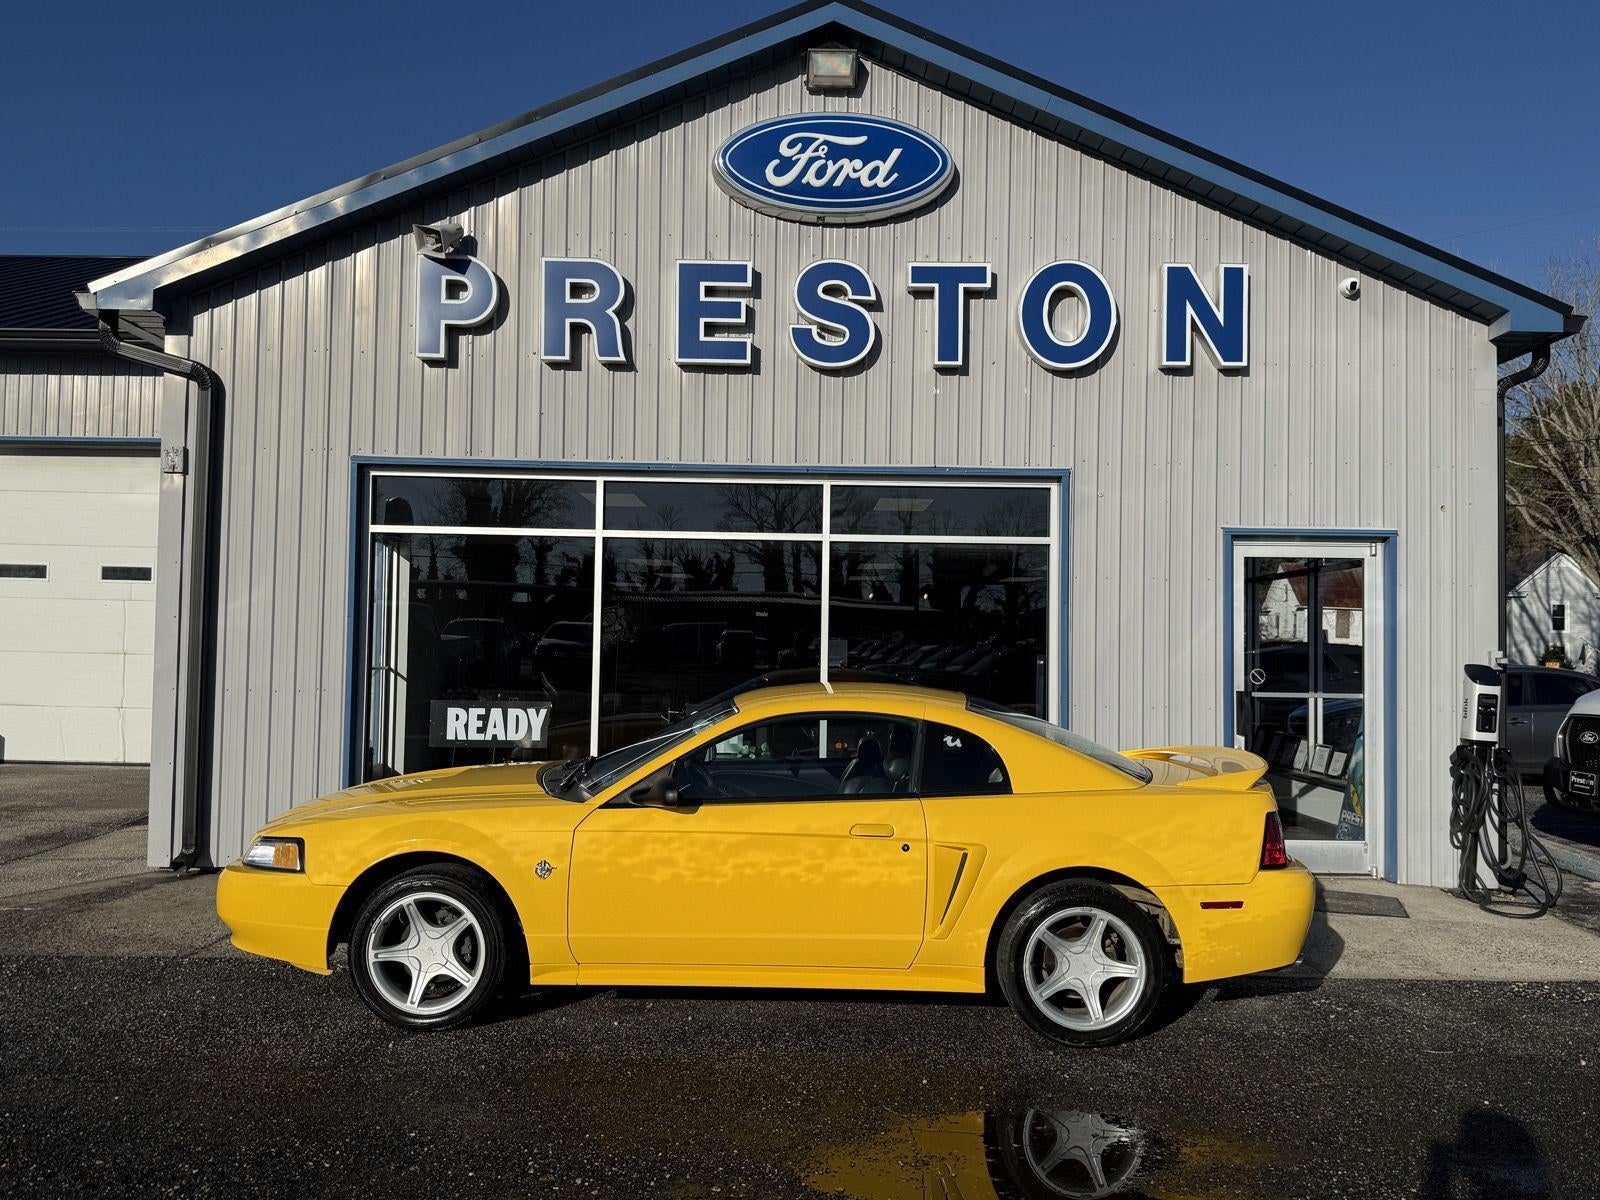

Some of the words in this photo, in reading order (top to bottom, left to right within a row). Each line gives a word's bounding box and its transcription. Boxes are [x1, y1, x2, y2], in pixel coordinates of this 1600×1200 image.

[765, 132, 903, 188] Ford
[415, 254, 1249, 371] PRESTON
[446, 707, 548, 741] READY
